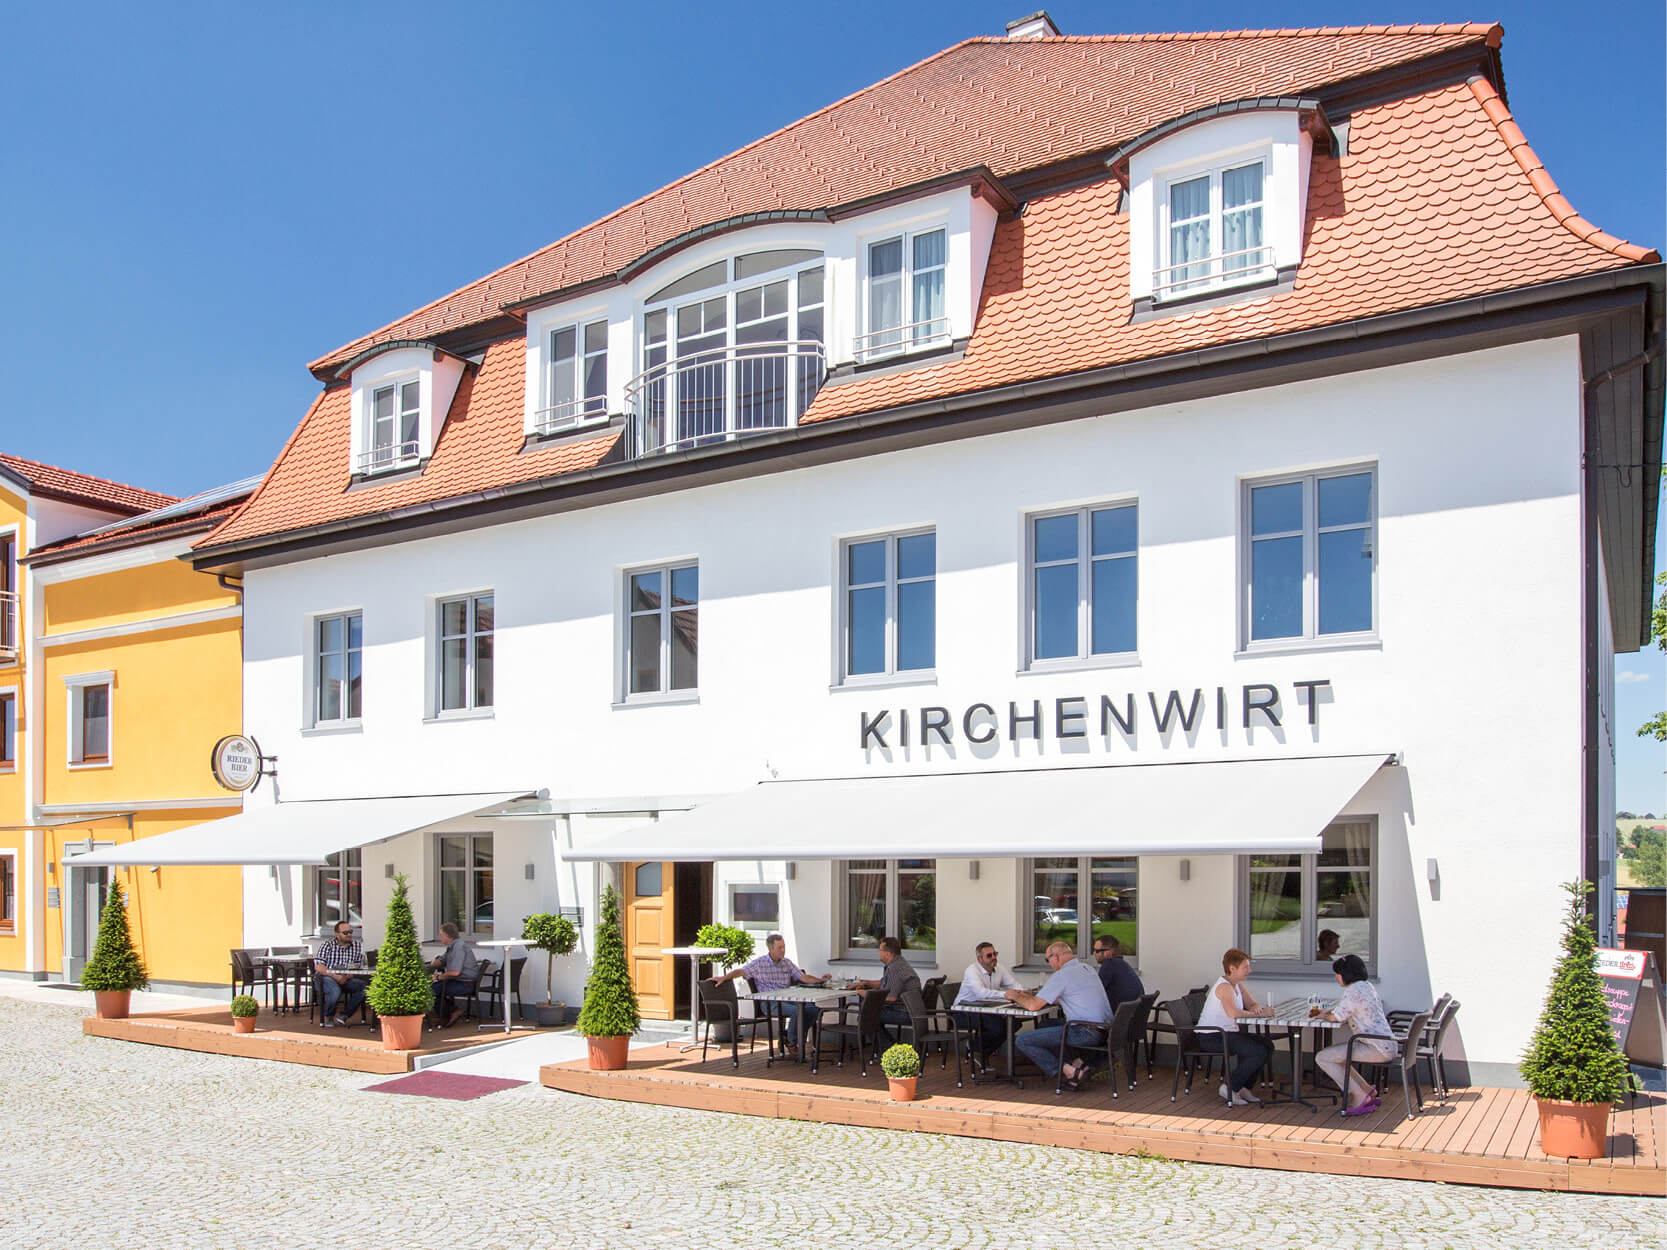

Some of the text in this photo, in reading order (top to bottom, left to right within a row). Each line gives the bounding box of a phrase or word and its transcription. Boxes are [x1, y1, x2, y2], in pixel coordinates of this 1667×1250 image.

[860, 679, 1331, 749] KIRCHENWIRT
[227, 755, 252, 764] RIEDER
[231, 763, 248, 772] BIER
